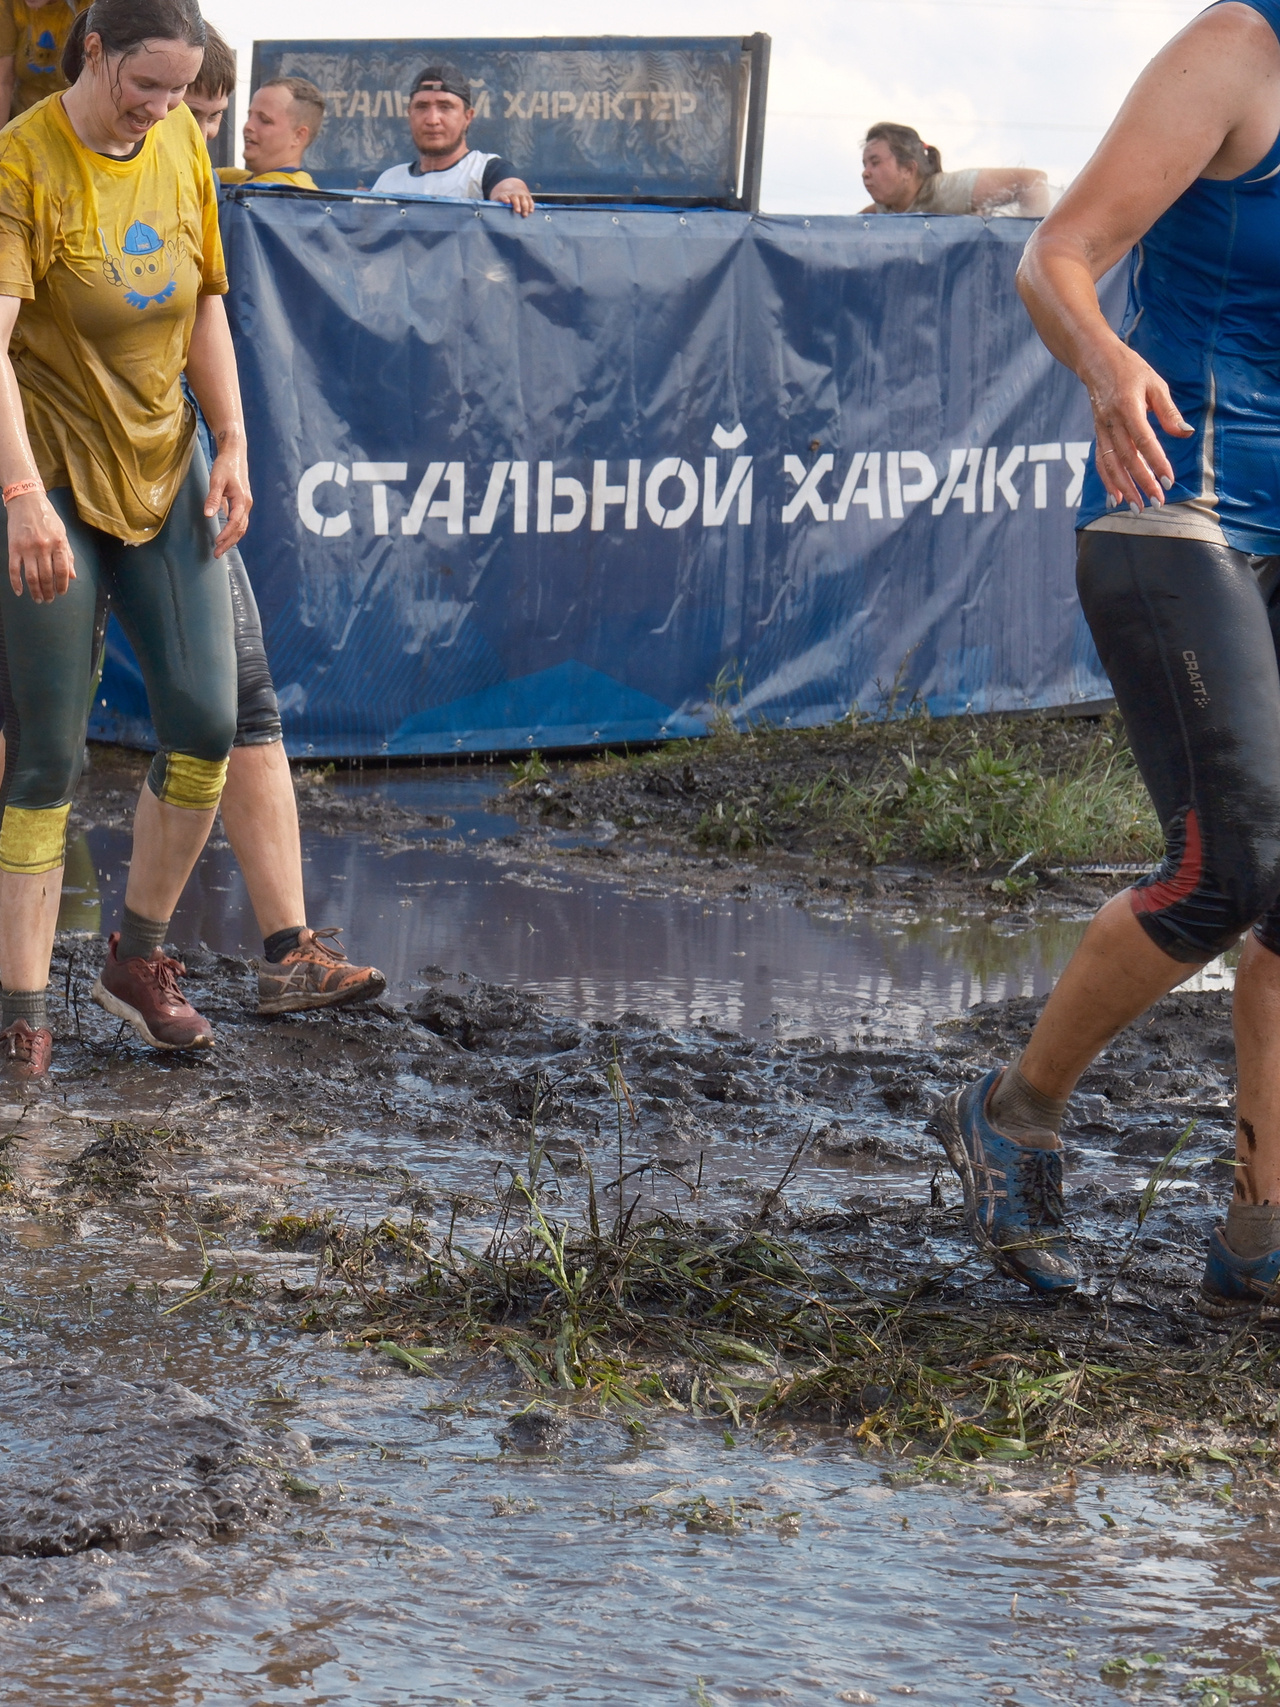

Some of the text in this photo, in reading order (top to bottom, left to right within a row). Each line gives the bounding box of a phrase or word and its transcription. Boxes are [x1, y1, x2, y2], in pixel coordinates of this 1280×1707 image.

[321, 78, 697, 121] ТАЛЬЙ ХАРАКТЕР
[297, 422, 1092, 537] СТАЛЬНОЙ ХАРАКТЕ
[1182, 650, 1207, 696] CRAFT
